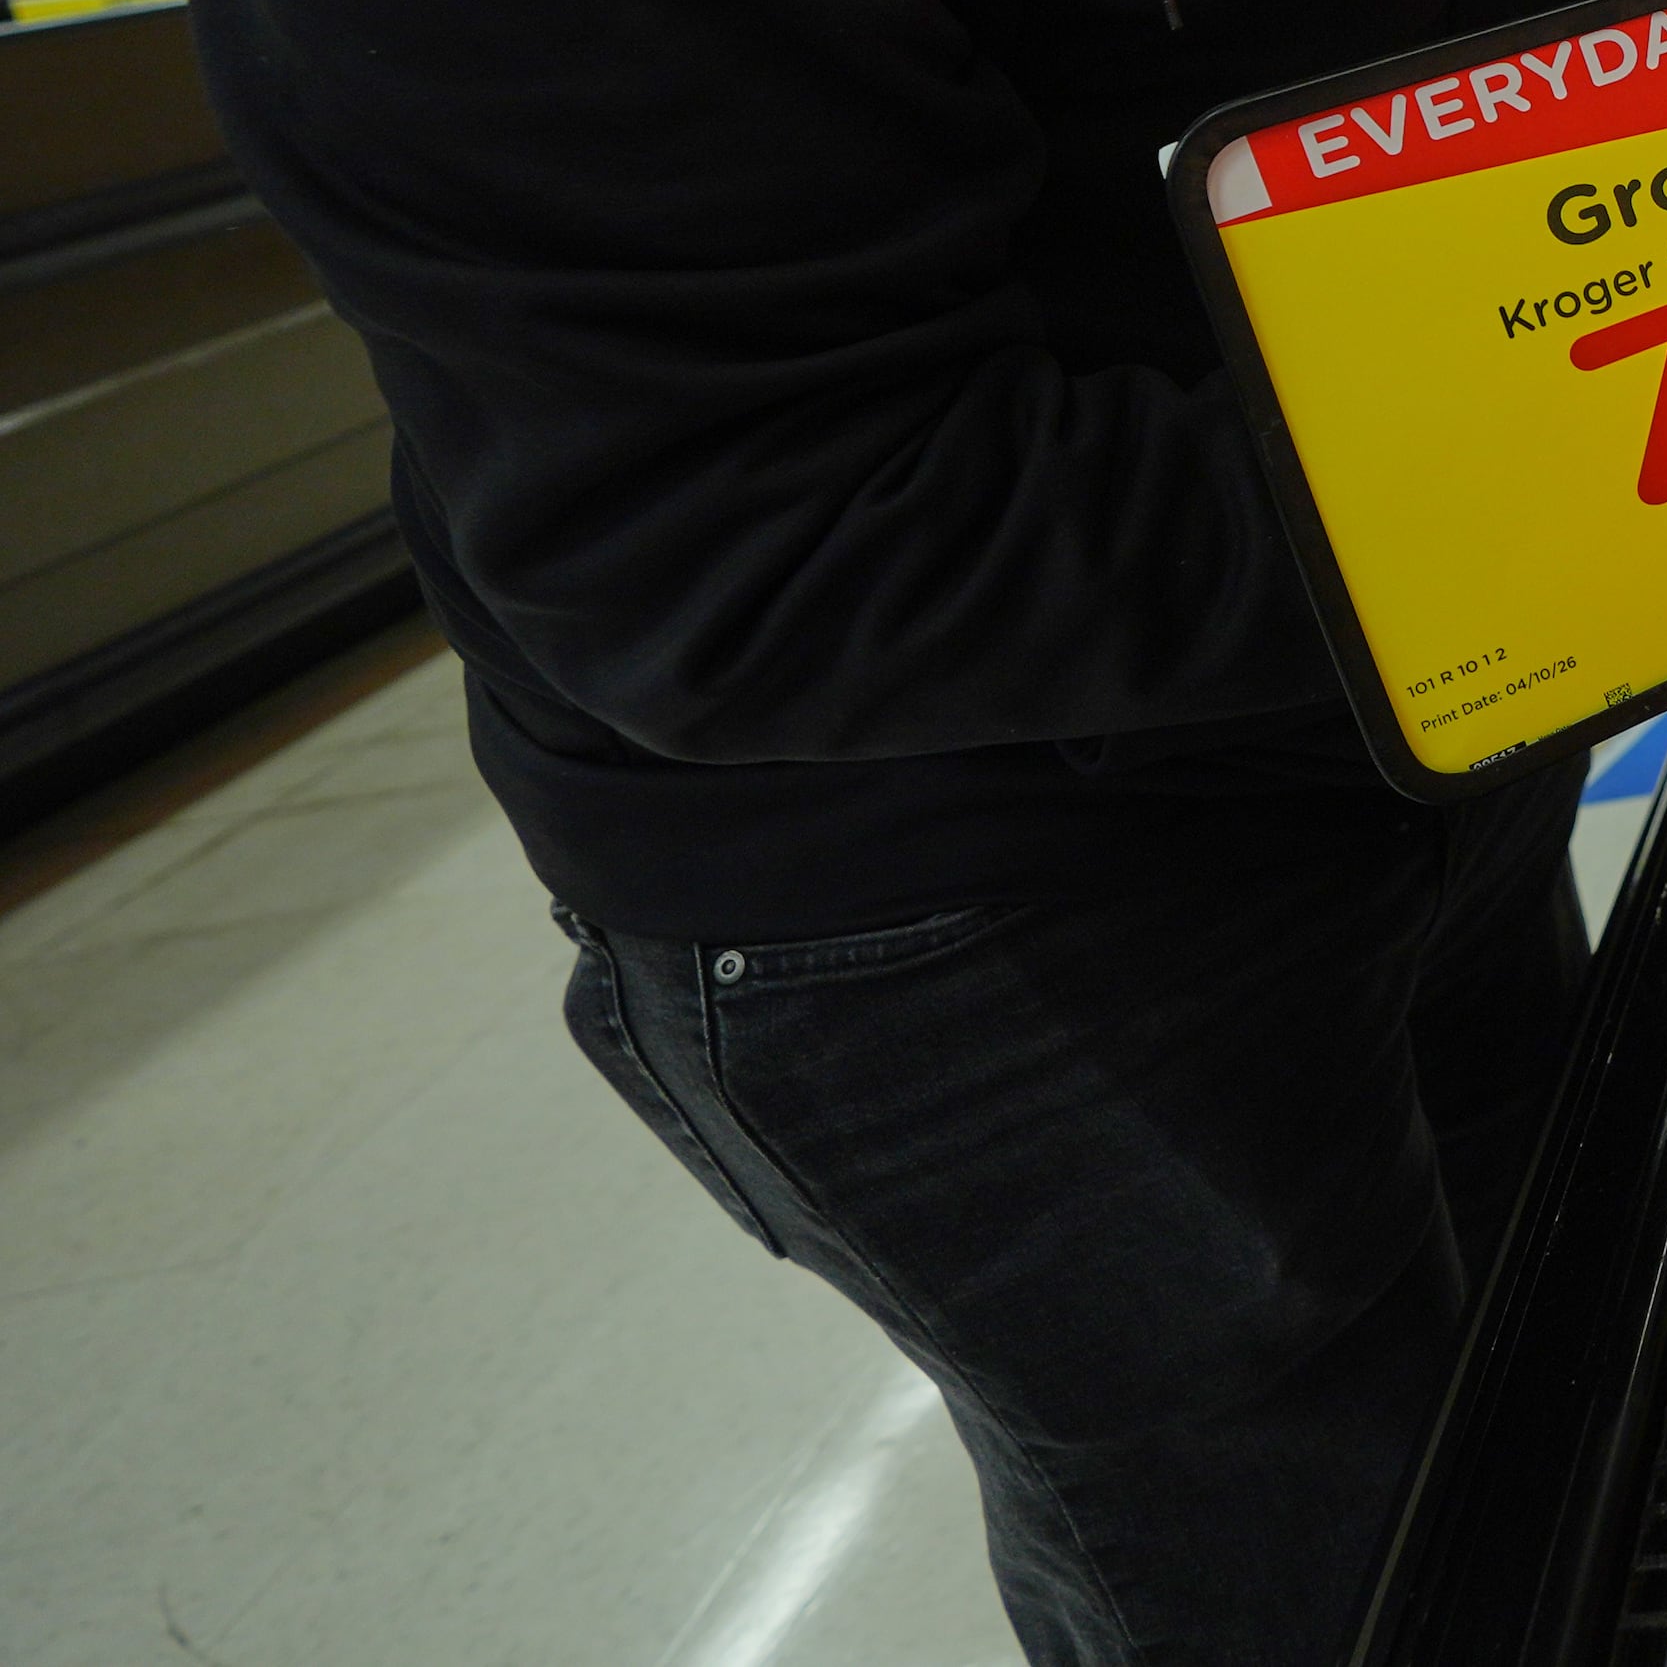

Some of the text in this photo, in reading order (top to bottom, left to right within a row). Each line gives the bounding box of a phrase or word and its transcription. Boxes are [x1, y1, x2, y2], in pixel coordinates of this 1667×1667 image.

[1498, 260, 1654, 340] Kroger
[1406, 647, 1508, 699] 101 R 10 1 2
[1420, 655, 1577, 733] Print Date: 04/10/26
